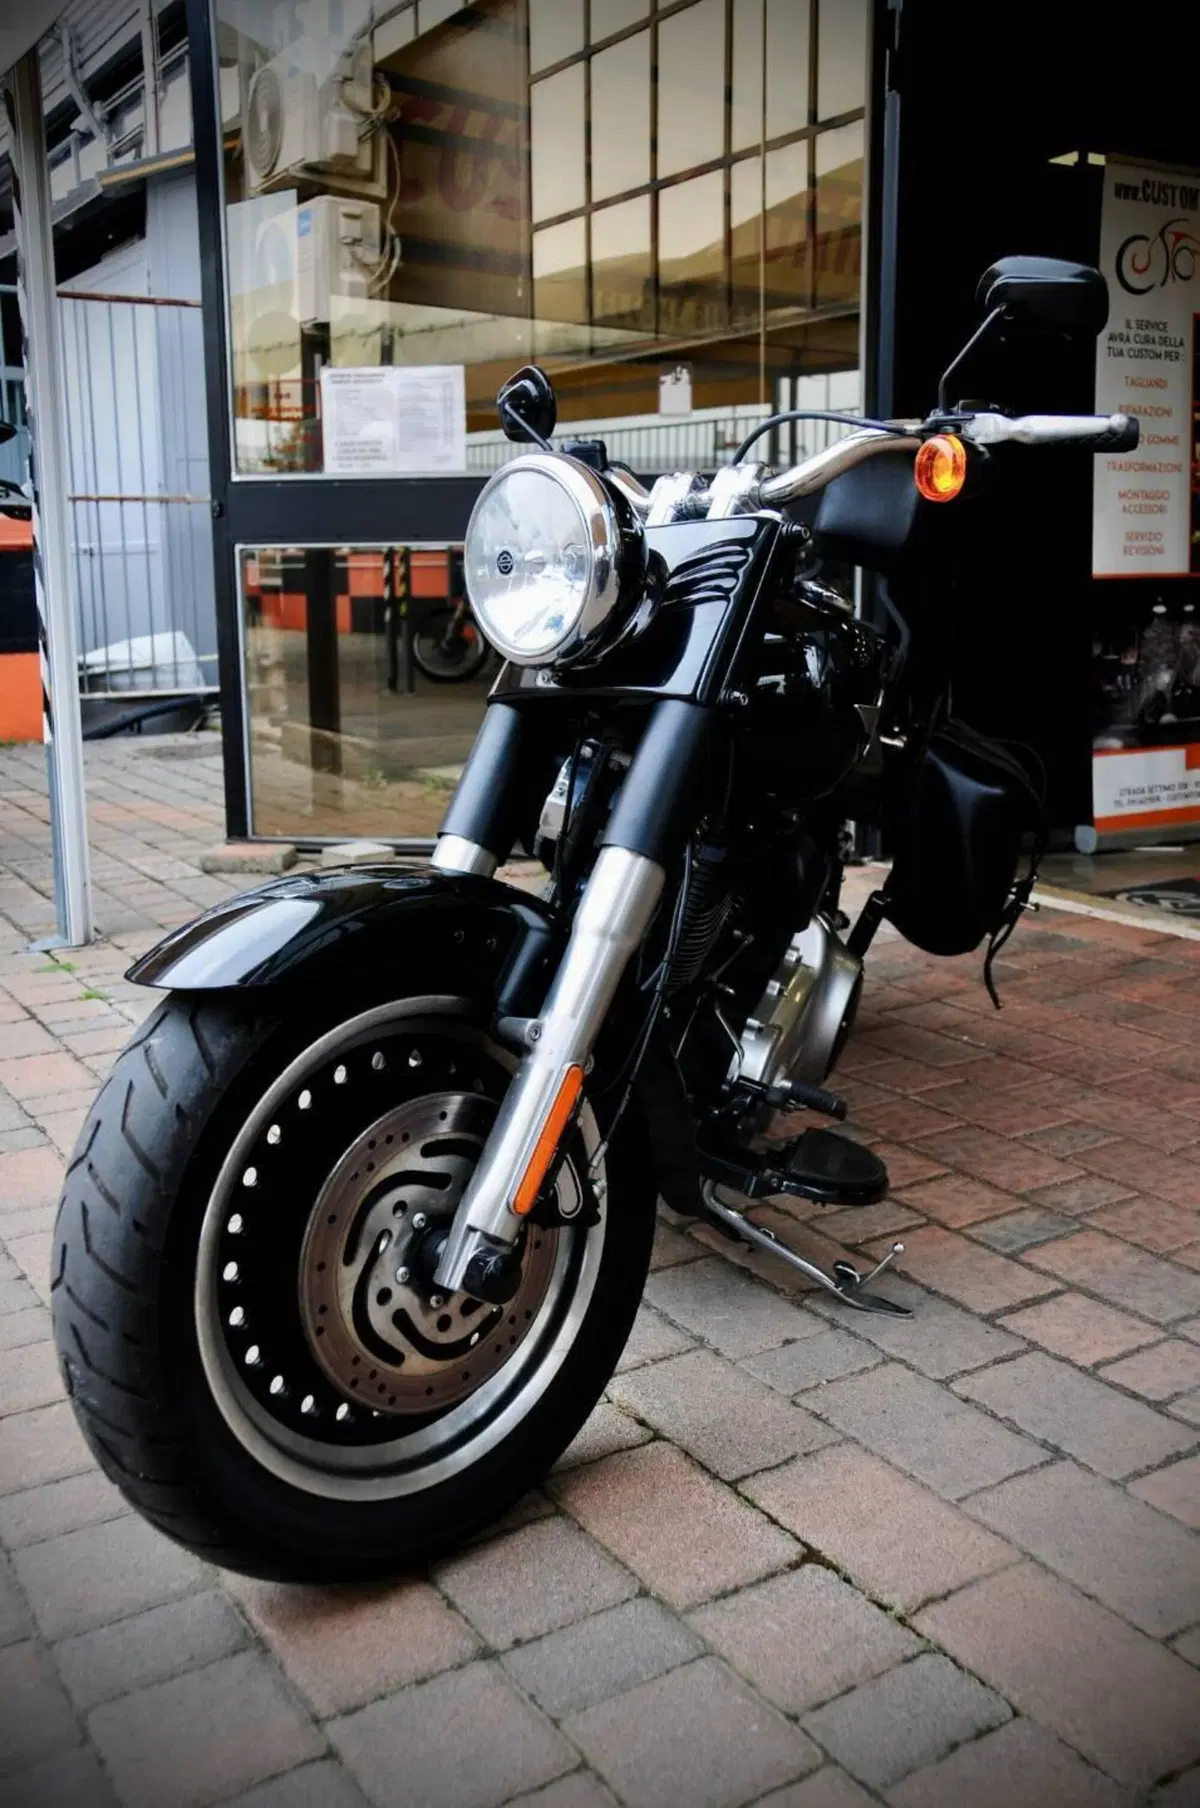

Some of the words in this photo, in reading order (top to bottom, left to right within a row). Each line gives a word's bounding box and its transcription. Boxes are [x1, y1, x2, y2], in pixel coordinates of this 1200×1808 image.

[1135, 319, 1168, 332] SERVICE
[1133, 333, 1156, 345] CURA
[1158, 336, 1184, 348] DELLA
[1107, 346, 1125, 357] TUA
[1127, 347, 1162, 360] CUSTOM
